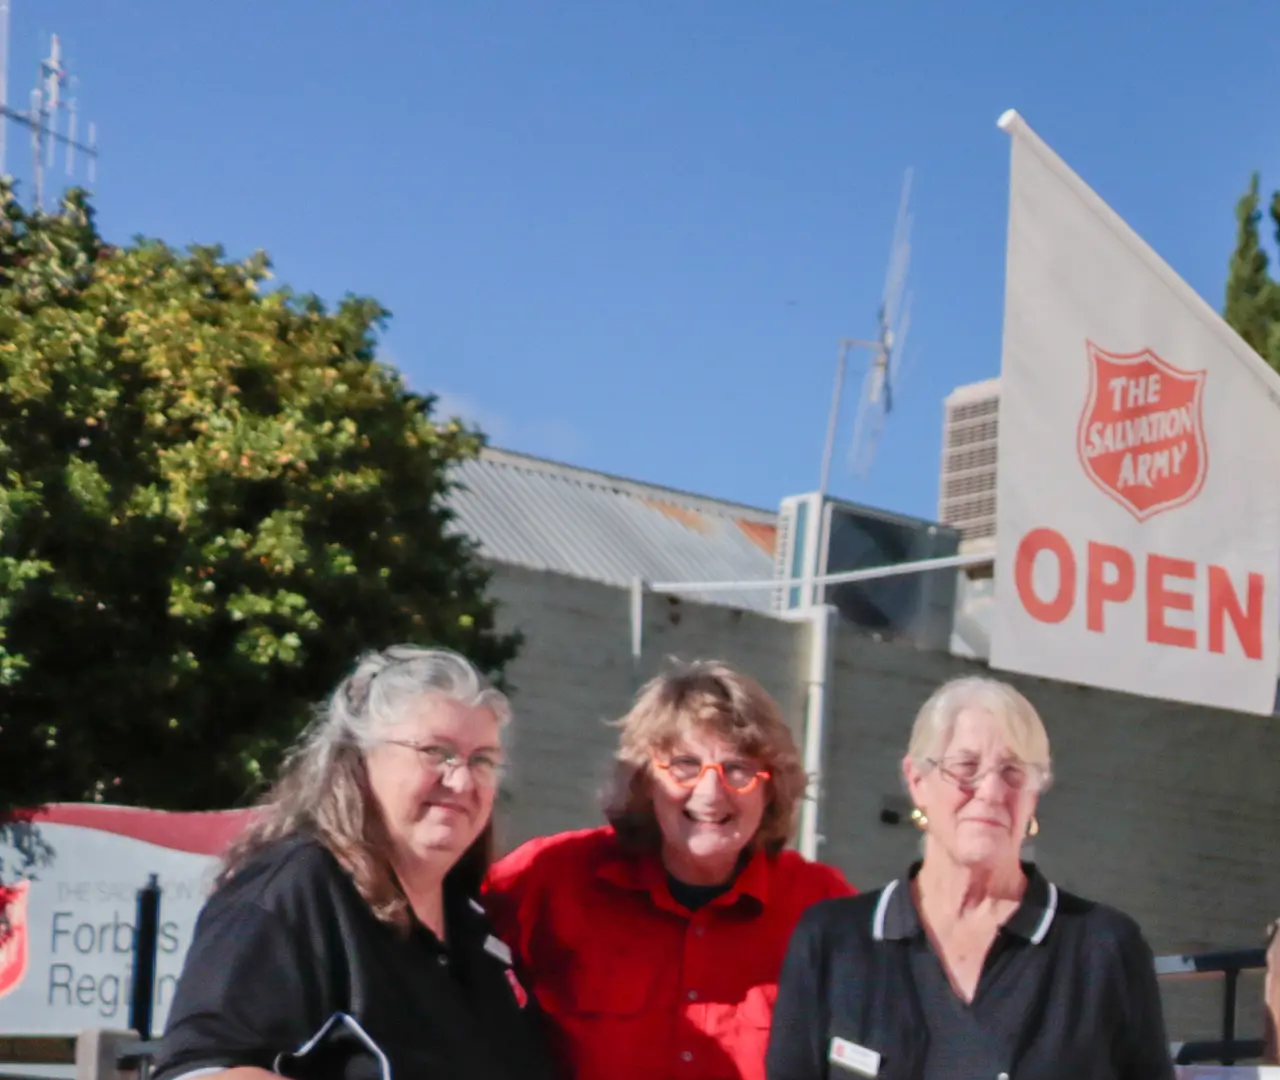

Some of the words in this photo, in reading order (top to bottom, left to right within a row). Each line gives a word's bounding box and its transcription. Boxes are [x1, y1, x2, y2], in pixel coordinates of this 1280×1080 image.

[1107, 373, 1161, 412] THE
[1084, 402, 1195, 458] SALVATION
[1116, 440, 1189, 490] ARMY
[1014, 525, 1265, 661] OPEN
[51, 910, 180, 954] Forbs
